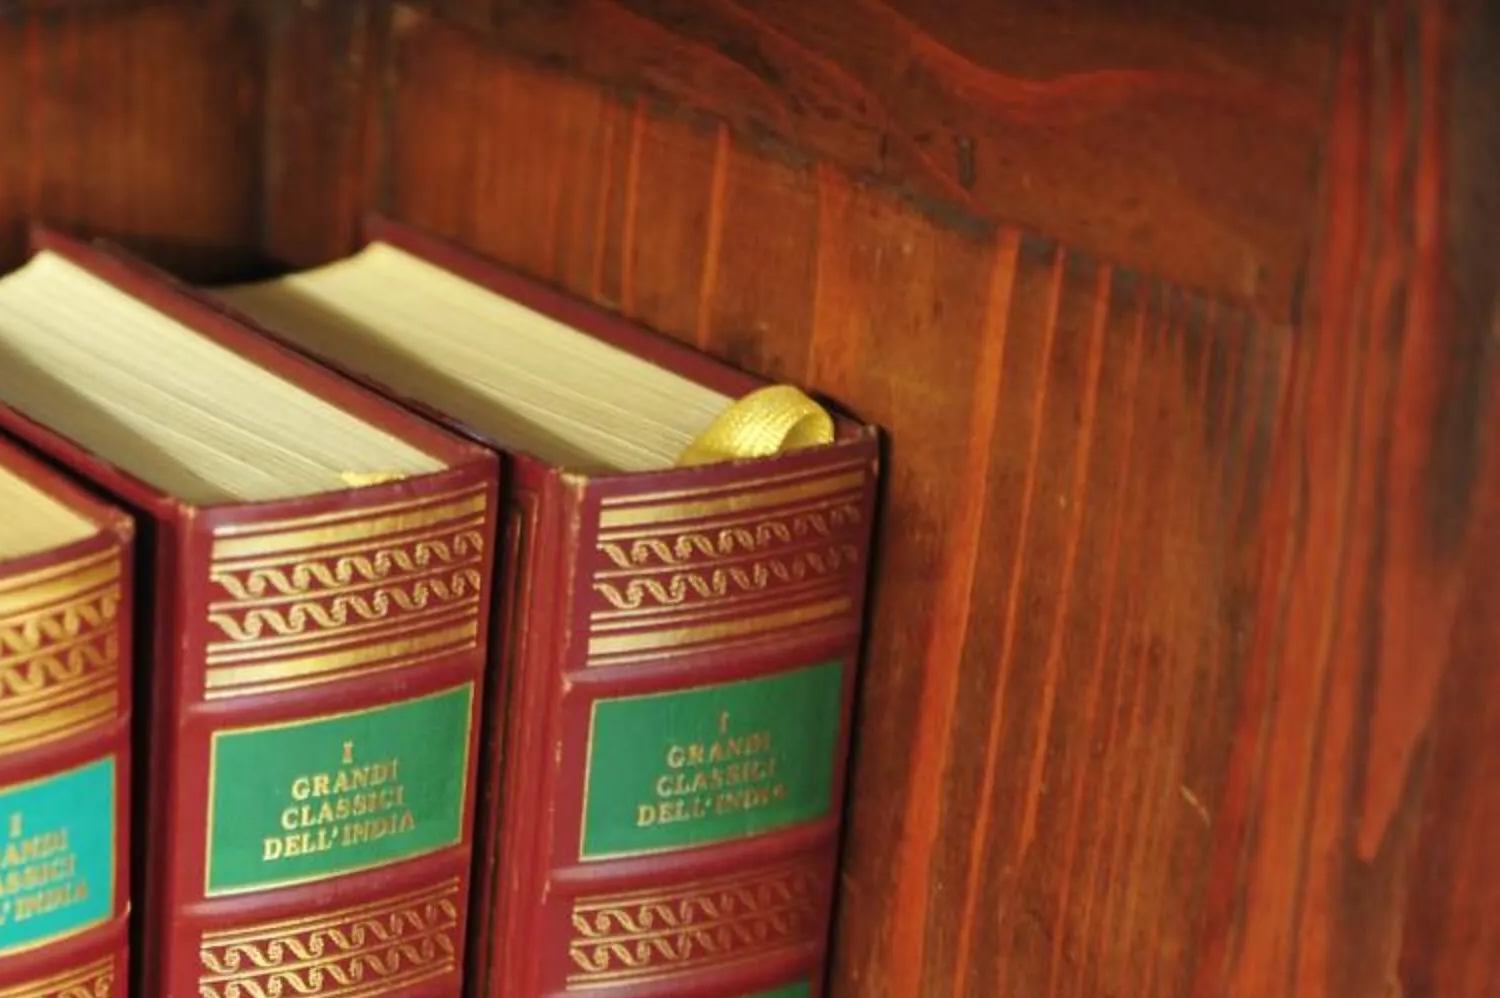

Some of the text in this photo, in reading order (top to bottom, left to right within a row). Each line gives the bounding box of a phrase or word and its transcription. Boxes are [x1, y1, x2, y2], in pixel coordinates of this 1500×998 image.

[719, 711, 730, 734] I
[342, 739, 354, 764] I
[666, 731, 772, 768] GRANDI
[292, 757, 397, 800] GRANDI
[657, 757, 777, 797] CLASSICI
[10, 811, 23, 837] I
[281, 784, 404, 830] CLASSICI
